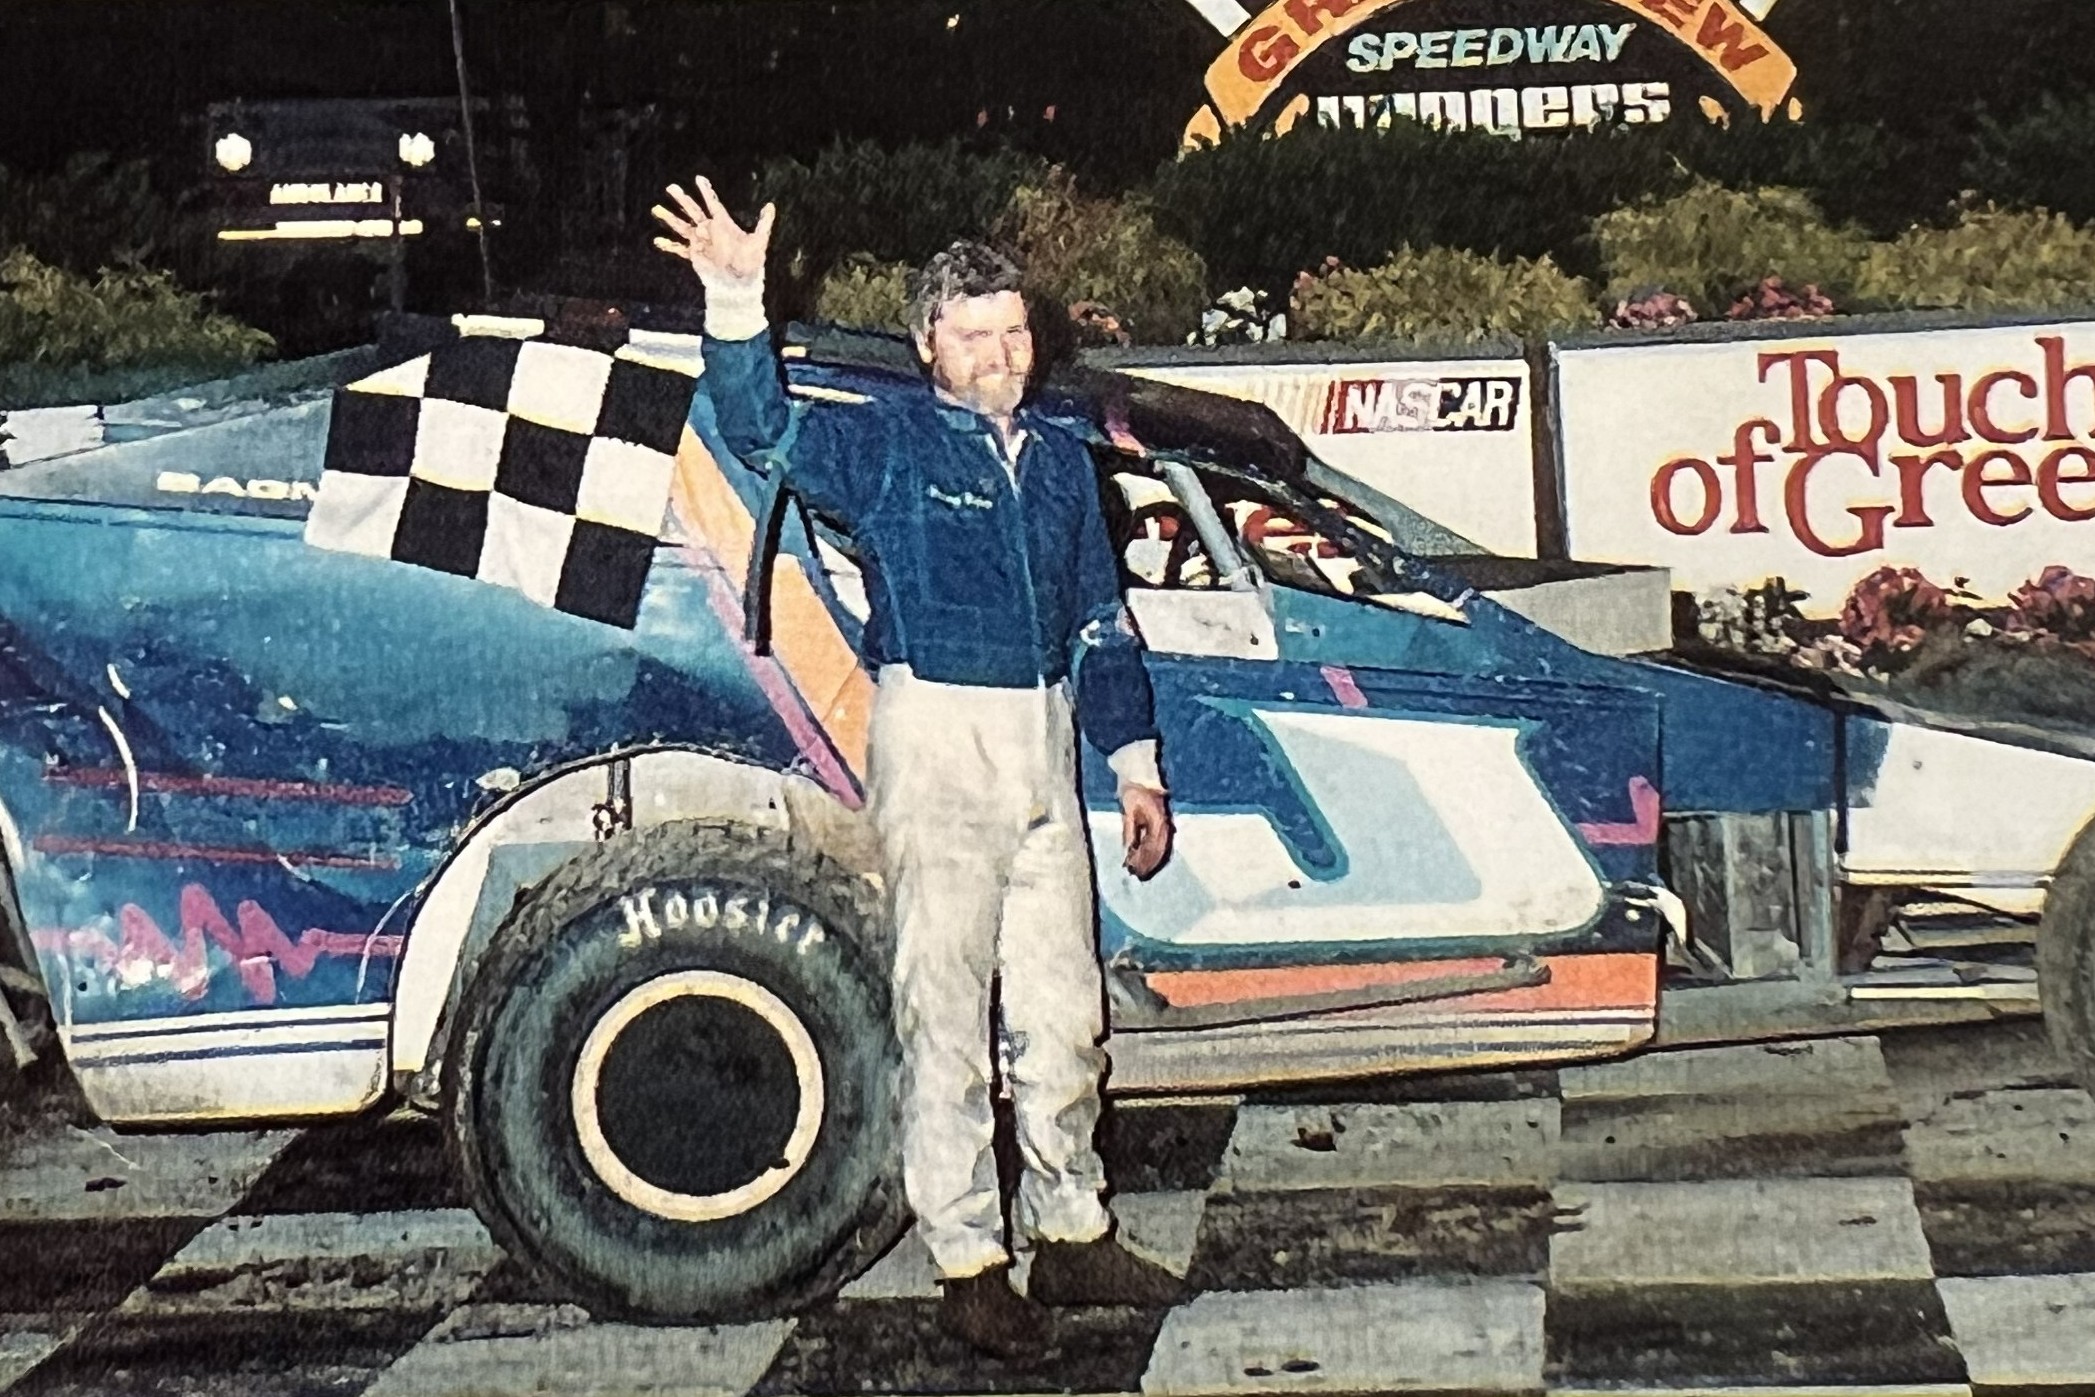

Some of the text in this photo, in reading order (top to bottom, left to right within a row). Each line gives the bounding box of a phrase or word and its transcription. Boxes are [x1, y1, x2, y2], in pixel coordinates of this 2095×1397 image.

[1346, 23, 1637, 73] SPEEDWAY
[1341, 378, 1516, 430] NASCAR
[1757, 336, 2095, 454] Touch
[1650, 418, 2095, 557] of Gree
